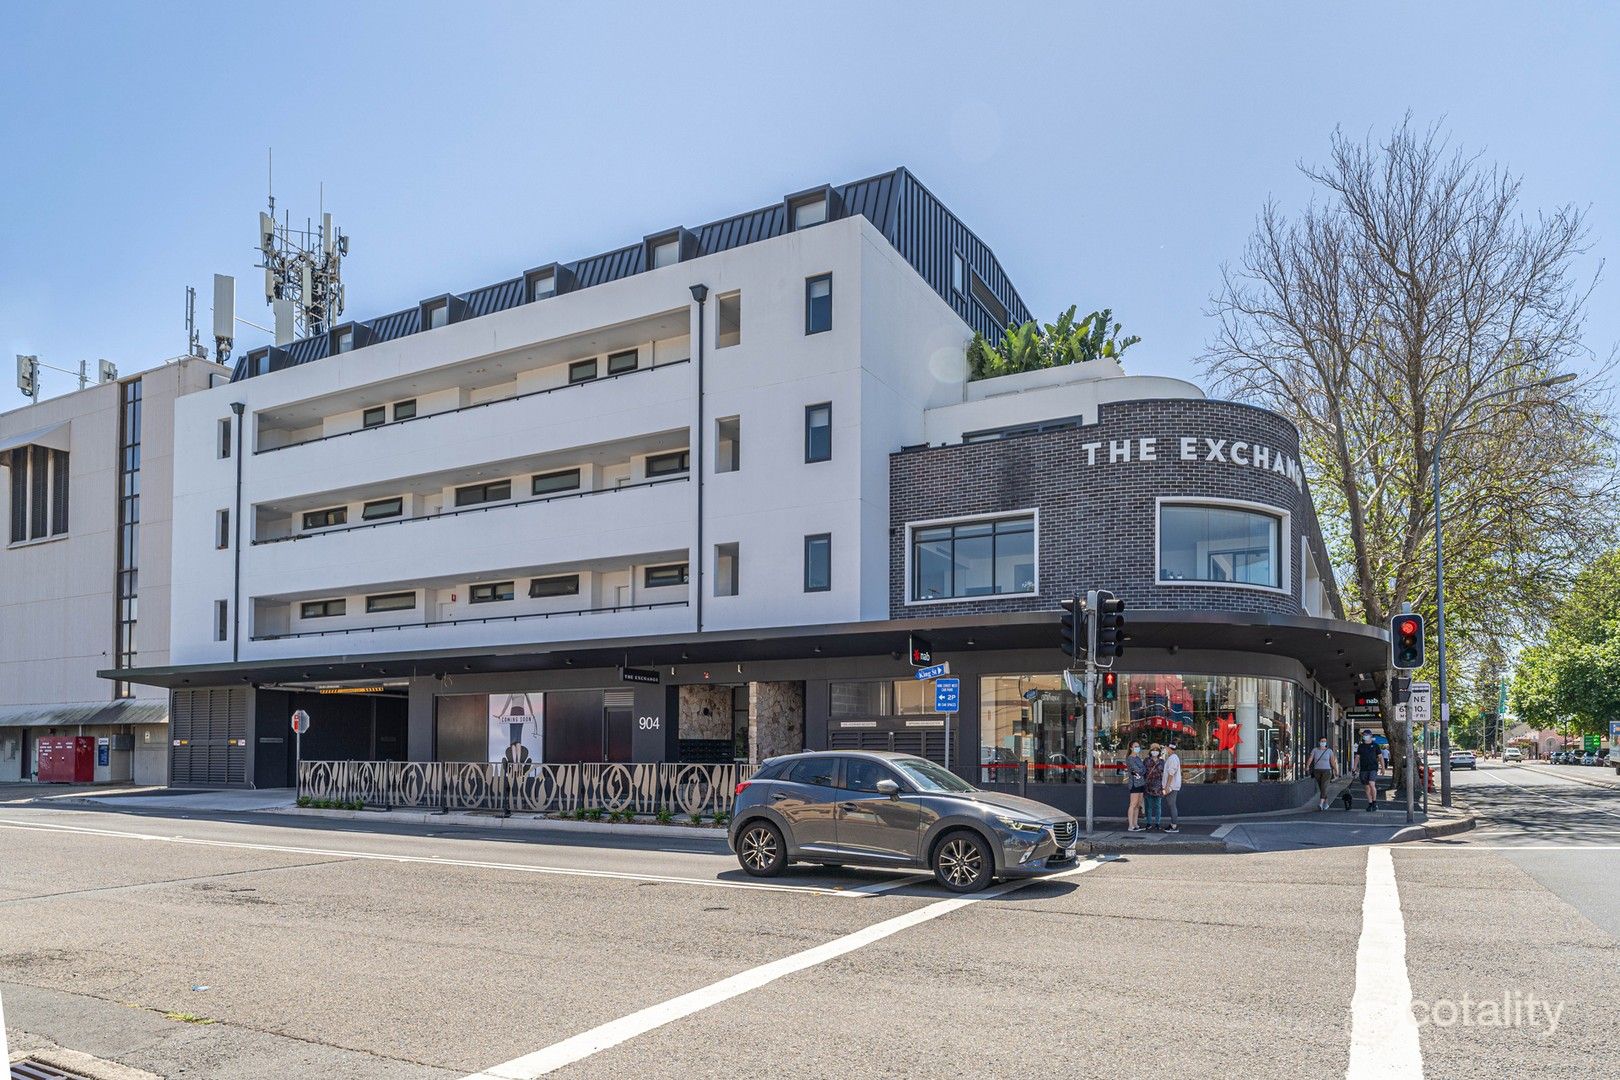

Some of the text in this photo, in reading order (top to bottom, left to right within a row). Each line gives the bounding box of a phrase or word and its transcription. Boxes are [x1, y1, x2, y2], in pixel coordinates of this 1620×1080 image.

[1081, 437, 1157, 465] THE
[634, 675, 659, 683] EXCHANGE
[919, 670, 932, 679] King
[639, 716, 660, 730] 904
